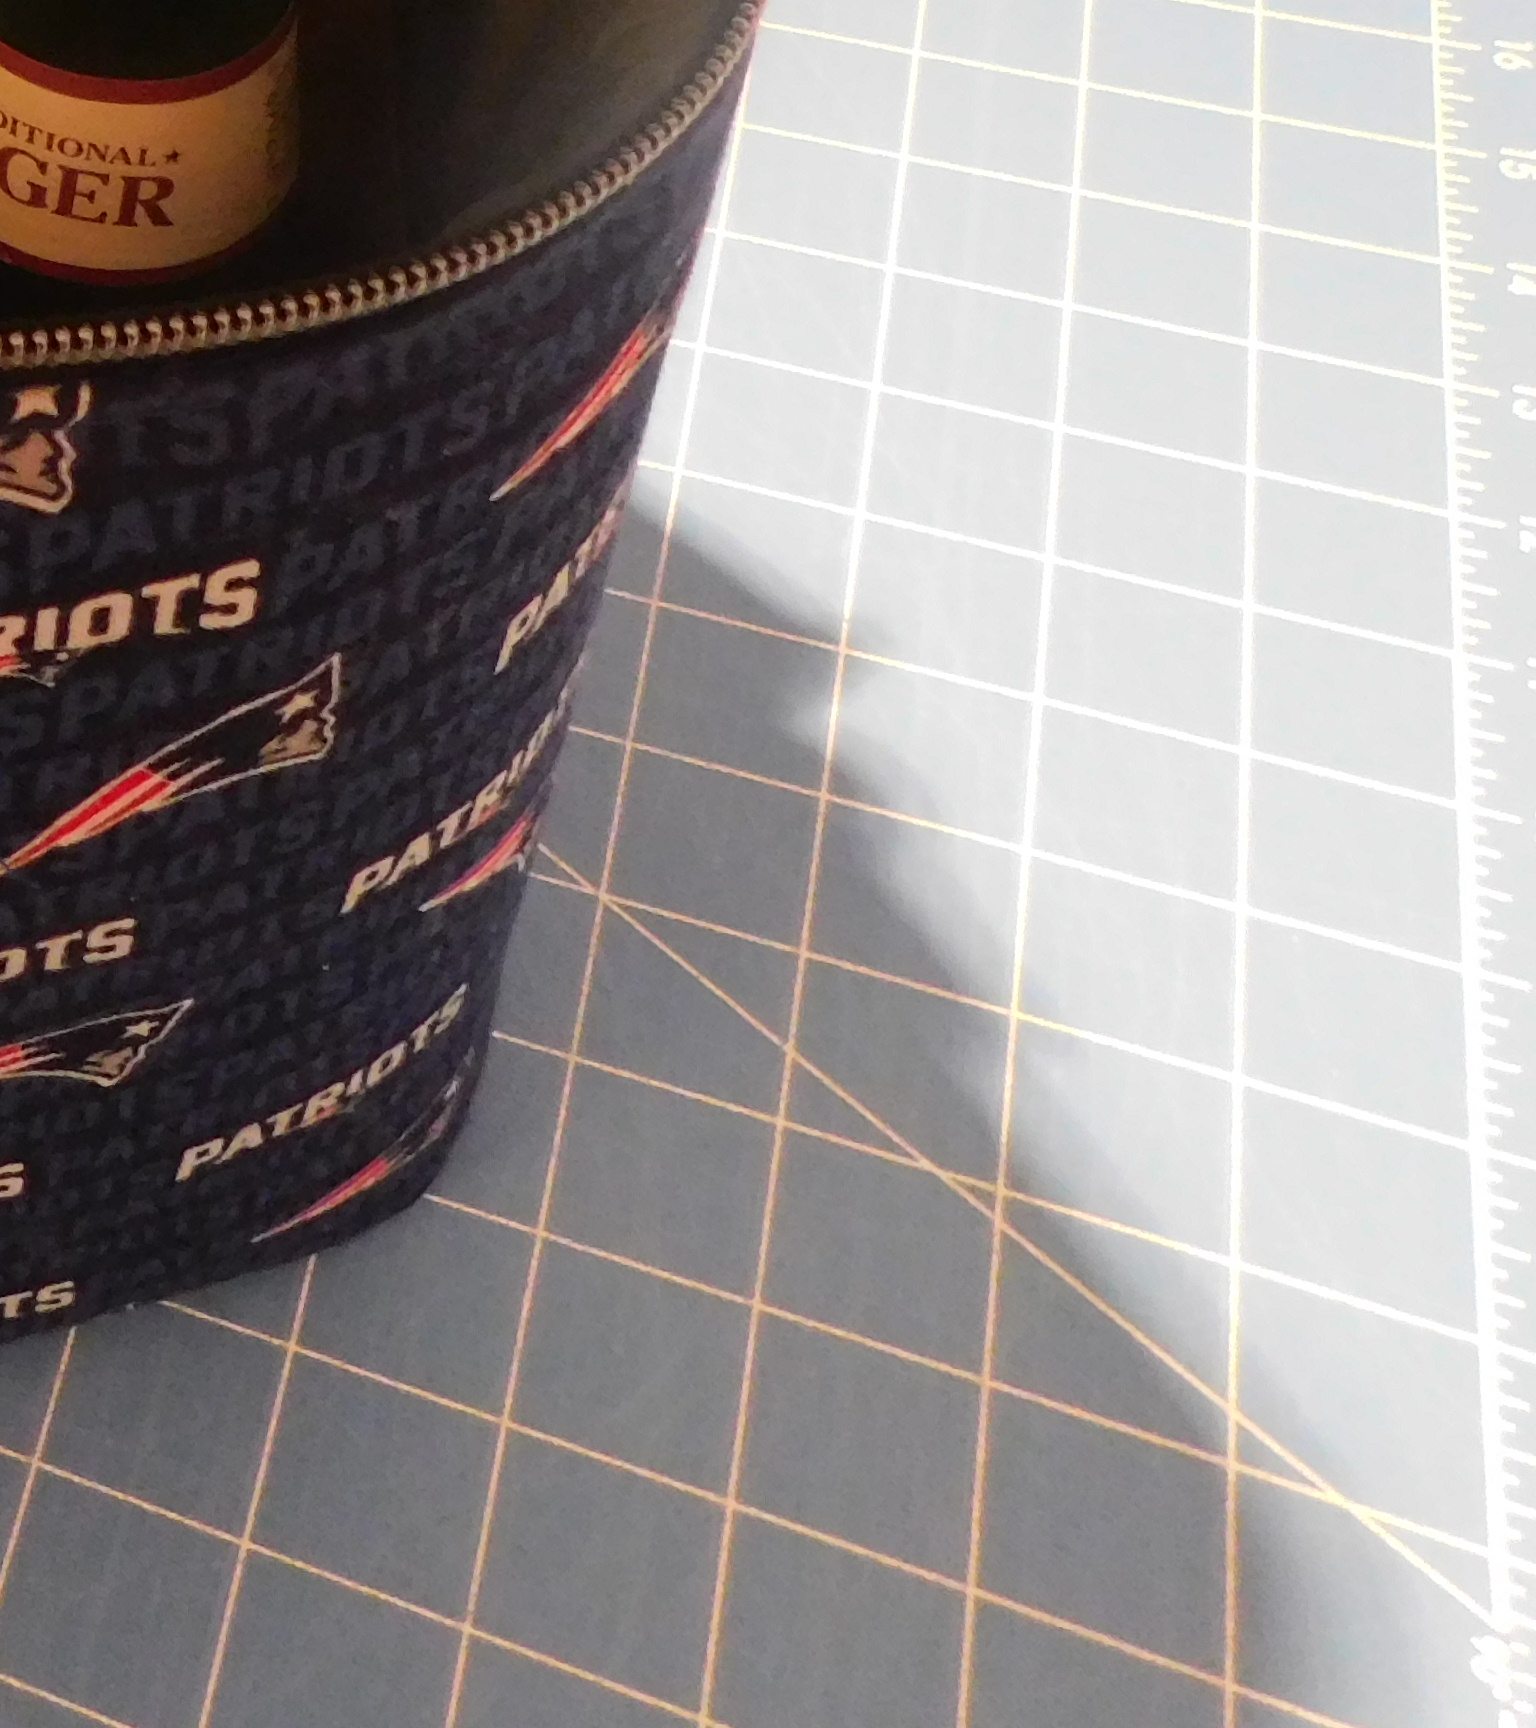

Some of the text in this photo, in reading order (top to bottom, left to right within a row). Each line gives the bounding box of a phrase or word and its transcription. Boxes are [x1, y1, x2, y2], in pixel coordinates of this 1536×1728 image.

[1492, 38, 1534, 71] 16
[1499, 146, 1536, 181] 15
[172, 983, 469, 1183] PATRIOTS
